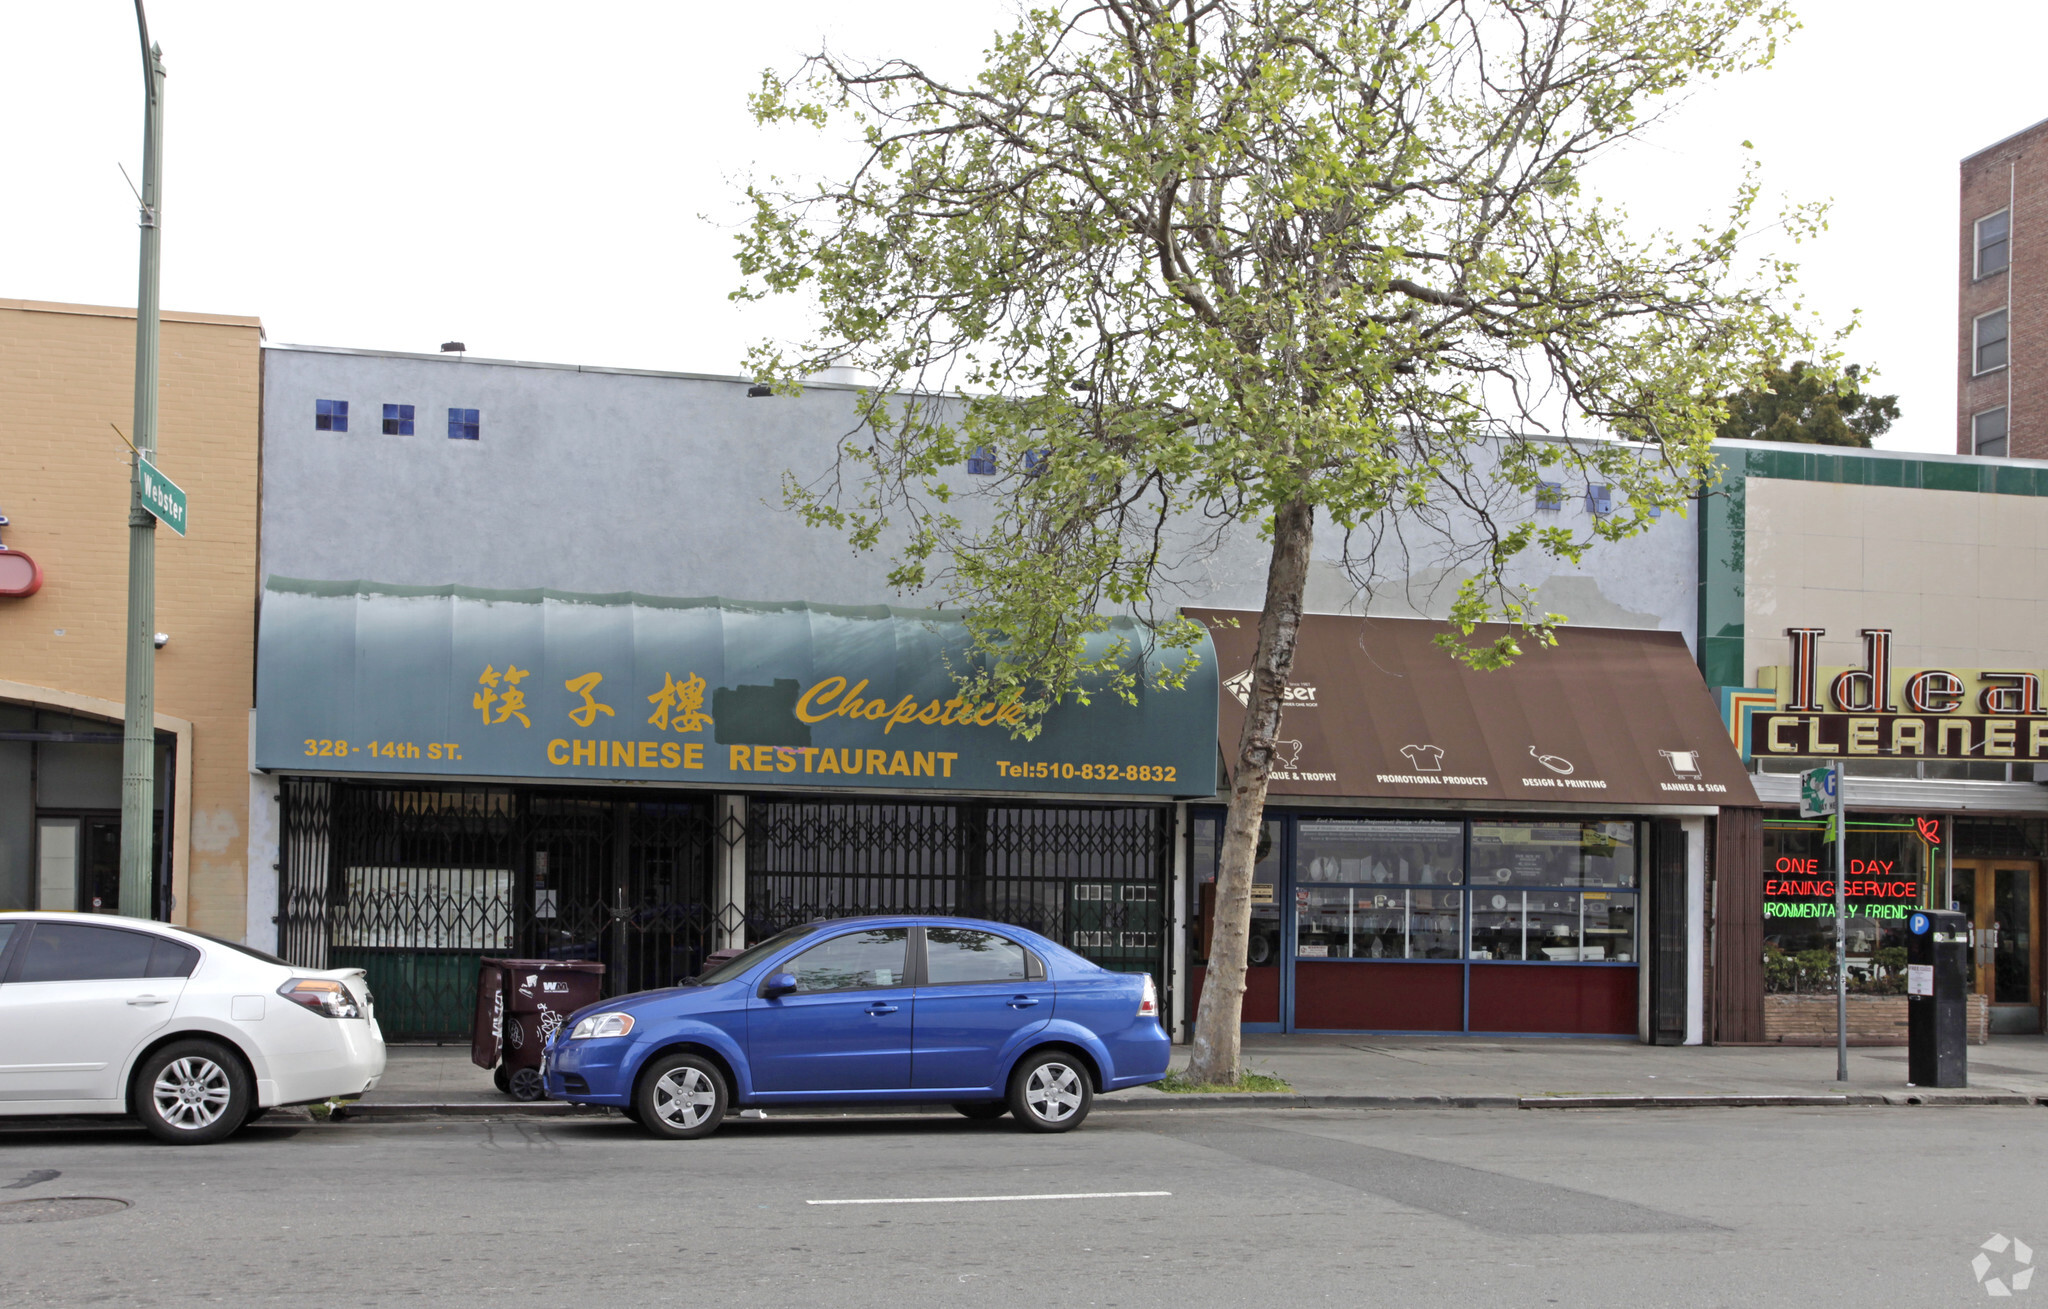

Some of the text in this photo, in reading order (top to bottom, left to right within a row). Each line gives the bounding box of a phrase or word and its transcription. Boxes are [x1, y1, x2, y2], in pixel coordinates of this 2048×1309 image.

[143, 471, 183, 522] Webster
[1785, 627, 2048, 713] Idea
[1284, 686, 1316, 700] ser
[796, 676, 1026, 735] Chopstick
[367, 741, 421, 759] 14th
[427, 742, 463, 760] ST.
[547, 738, 958, 778] CHINESE RESTAURANT
[996, 760, 1177, 782] Tel:510-832-8832
[1268, 771, 1337, 781] AQUE & TROPHY
[1377, 774, 1488, 786] PROMOTIONAL PRODUCTS
[1522, 777, 1607, 789] DESIGN & PRINTING
[1661, 783, 1727, 793] BANNER & SIGN
[1776, 857, 1893, 875] ONE DAY
[1765, 880, 1917, 897] EANING SERVICE
[1865, 904, 1923, 919] FRIEND
[1914, 916, 1924, 932] P
